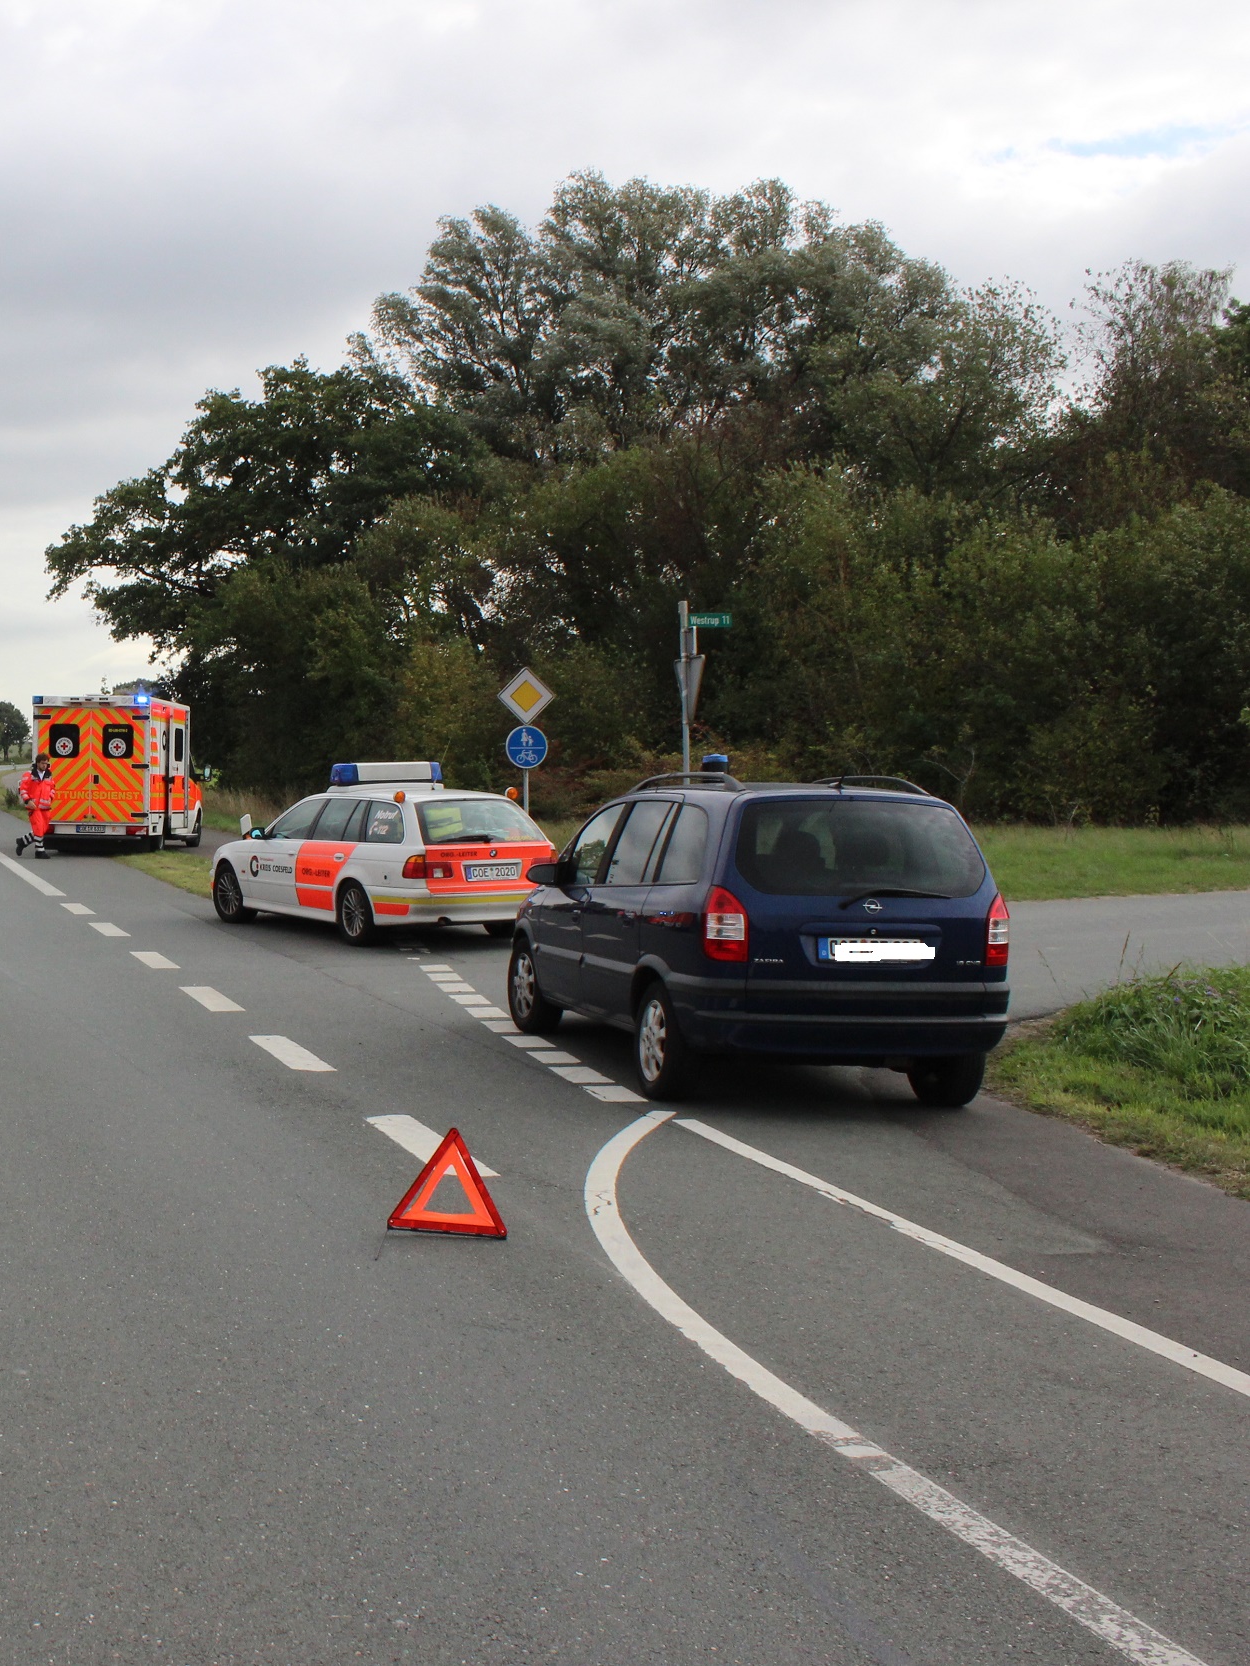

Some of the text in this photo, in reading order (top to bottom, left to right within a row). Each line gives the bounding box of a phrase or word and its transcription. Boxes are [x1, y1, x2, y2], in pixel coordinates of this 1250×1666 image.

[690, 615, 730, 626] Westrup 11
[55, 790, 141, 800] TTUNGSDIENST
[374, 810, 399, 819] Notruf
[260, 863, 293, 874] KREIS COESFELD
[472, 866, 516, 878] COE 2020
